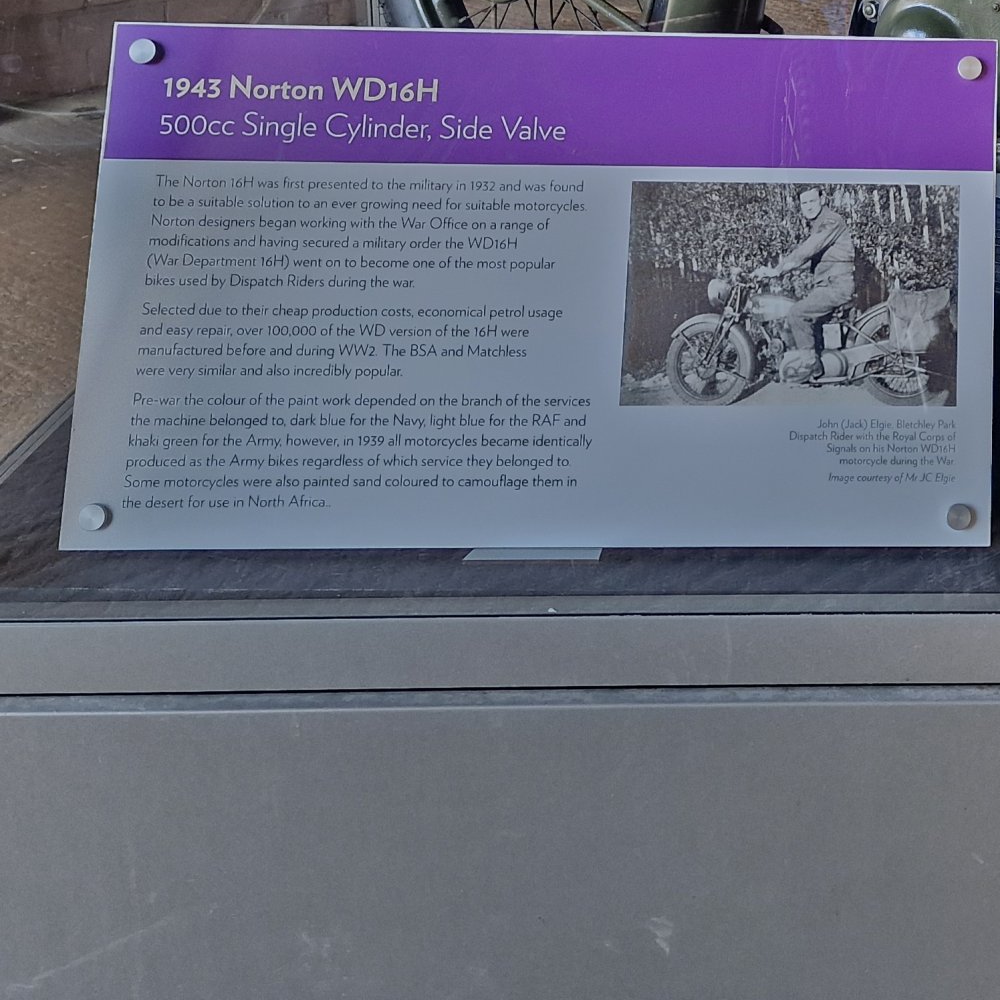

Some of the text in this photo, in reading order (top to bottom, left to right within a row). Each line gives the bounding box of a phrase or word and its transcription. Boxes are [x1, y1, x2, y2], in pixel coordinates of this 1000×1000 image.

[163, 75, 439, 102] 1943 Norton WD16H
[160, 111, 566, 144] 500cc Single Cylinder, Side Valve
[155, 174, 179, 189] The
[183, 175, 226, 190] Norton
[231, 176, 254, 188] 16H
[257, 180, 278, 188] was
[283, 176, 304, 191] first
[307, 178, 368, 192] presented
[371, 181, 383, 190] to
[387, 178, 406, 190] the
[409, 178, 453, 193] military
[456, 180, 466, 191] in
[471, 181, 495, 191] 1932
[499, 179, 521, 191] and
[550, 180, 584, 192] found
[151, 213, 194, 230] Norton
[198, 214, 255, 230] designers
[259, 215, 296, 231] began
[300, 216, 346, 231] working
[350, 216, 374, 228] with
[378, 216, 397, 229] the
[401, 217, 426, 229] War
[430, 216, 468, 229] Office
[490, 222, 496, 230] a
[500, 222, 533, 233] range
[537, 217, 550, 230] of
[149, 233, 517, 251] modifications and having secured a military order the WD16H
[144, 273, 175, 286] bikes
[179, 272, 208, 286] used
[209, 273, 226, 289] by
[229, 273, 283, 289] Dispatch
[287, 274, 324, 287] Riders
[328, 274, 366, 290] during
[370, 275, 389, 287] the
[141, 302, 195, 315] Selected
[198, 302, 221, 315] due
[225, 306, 237, 315] to
[242, 303, 268, 316] their
[272, 304, 308, 319] cheap
[311, 304, 377, 318] production
[417, 305, 486, 317] economical
[489, 305, 524, 320] petrol
[528, 309, 562, 321] usage
[138, 342, 223, 358] manufactured
[226, 342, 266, 356] before
[270, 343, 292, 356] and
[295, 343, 334, 359] during
[382, 343, 406, 356] The
[410, 343, 437, 356] BSA
[441, 344, 463, 357] and
[467, 344, 527, 357] Matchless
[168, 367, 195, 379] very
[198, 363, 236, 375] similar
[240, 363, 263, 376] and
[266, 363, 290, 376] also
[293, 363, 352, 379] incredibly
[354, 364, 402, 379] popular.
[817, 419, 838, 428] John
[840, 419, 867, 431] (Jack)
[896, 419, 935, 431] Bletchley
[938, 419, 955, 429] Park
[789, 430, 955, 443] Dispatch Rider with the Royal Corps of
[826, 442, 956, 455] Signals on his Norton WD16H
[839, 455, 887, 466] motorcycle
[889, 455, 917, 467] during
[920, 455, 934, 465] the
[828, 472, 955, 484] Image courtesy of Mr JC Elgie
[122, 496, 141, 508] the
[145, 496, 184, 508] desert
[188, 494, 205, 508] for
[208, 499, 229, 508] use
[233, 497, 244, 507] in
[248, 495, 284, 507] North
